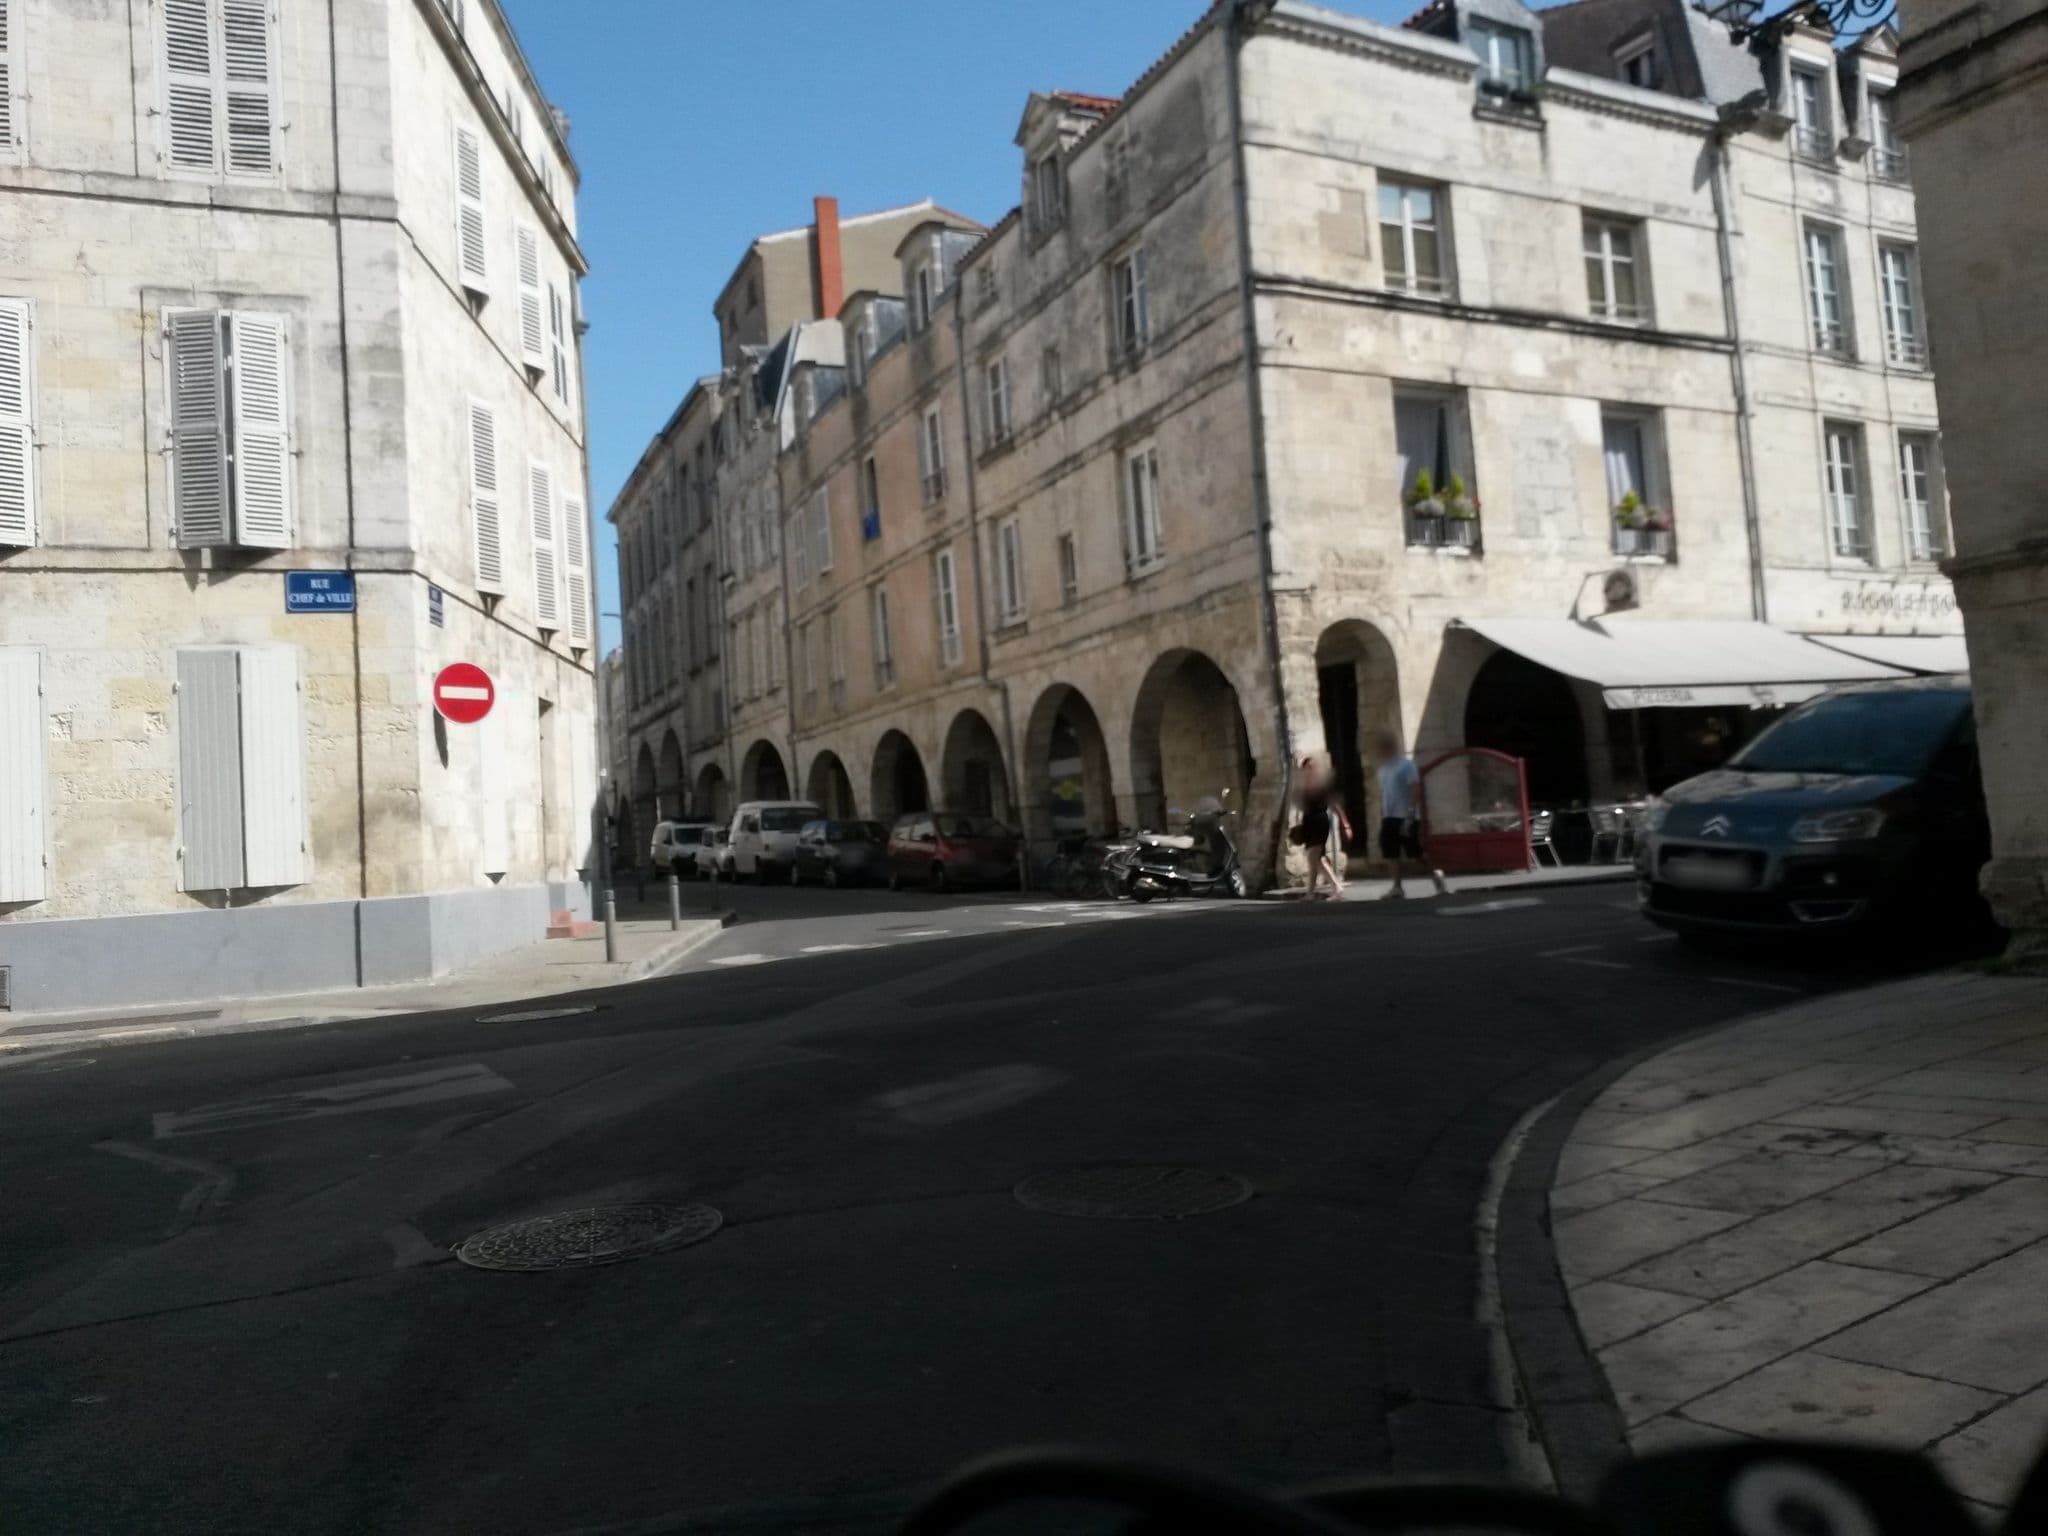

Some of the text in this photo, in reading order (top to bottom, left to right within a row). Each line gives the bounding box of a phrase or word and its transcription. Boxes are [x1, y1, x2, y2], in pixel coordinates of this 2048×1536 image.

[310, 579, 330, 589] RUE
[289, 592, 352, 603] CHEF de VILLE
